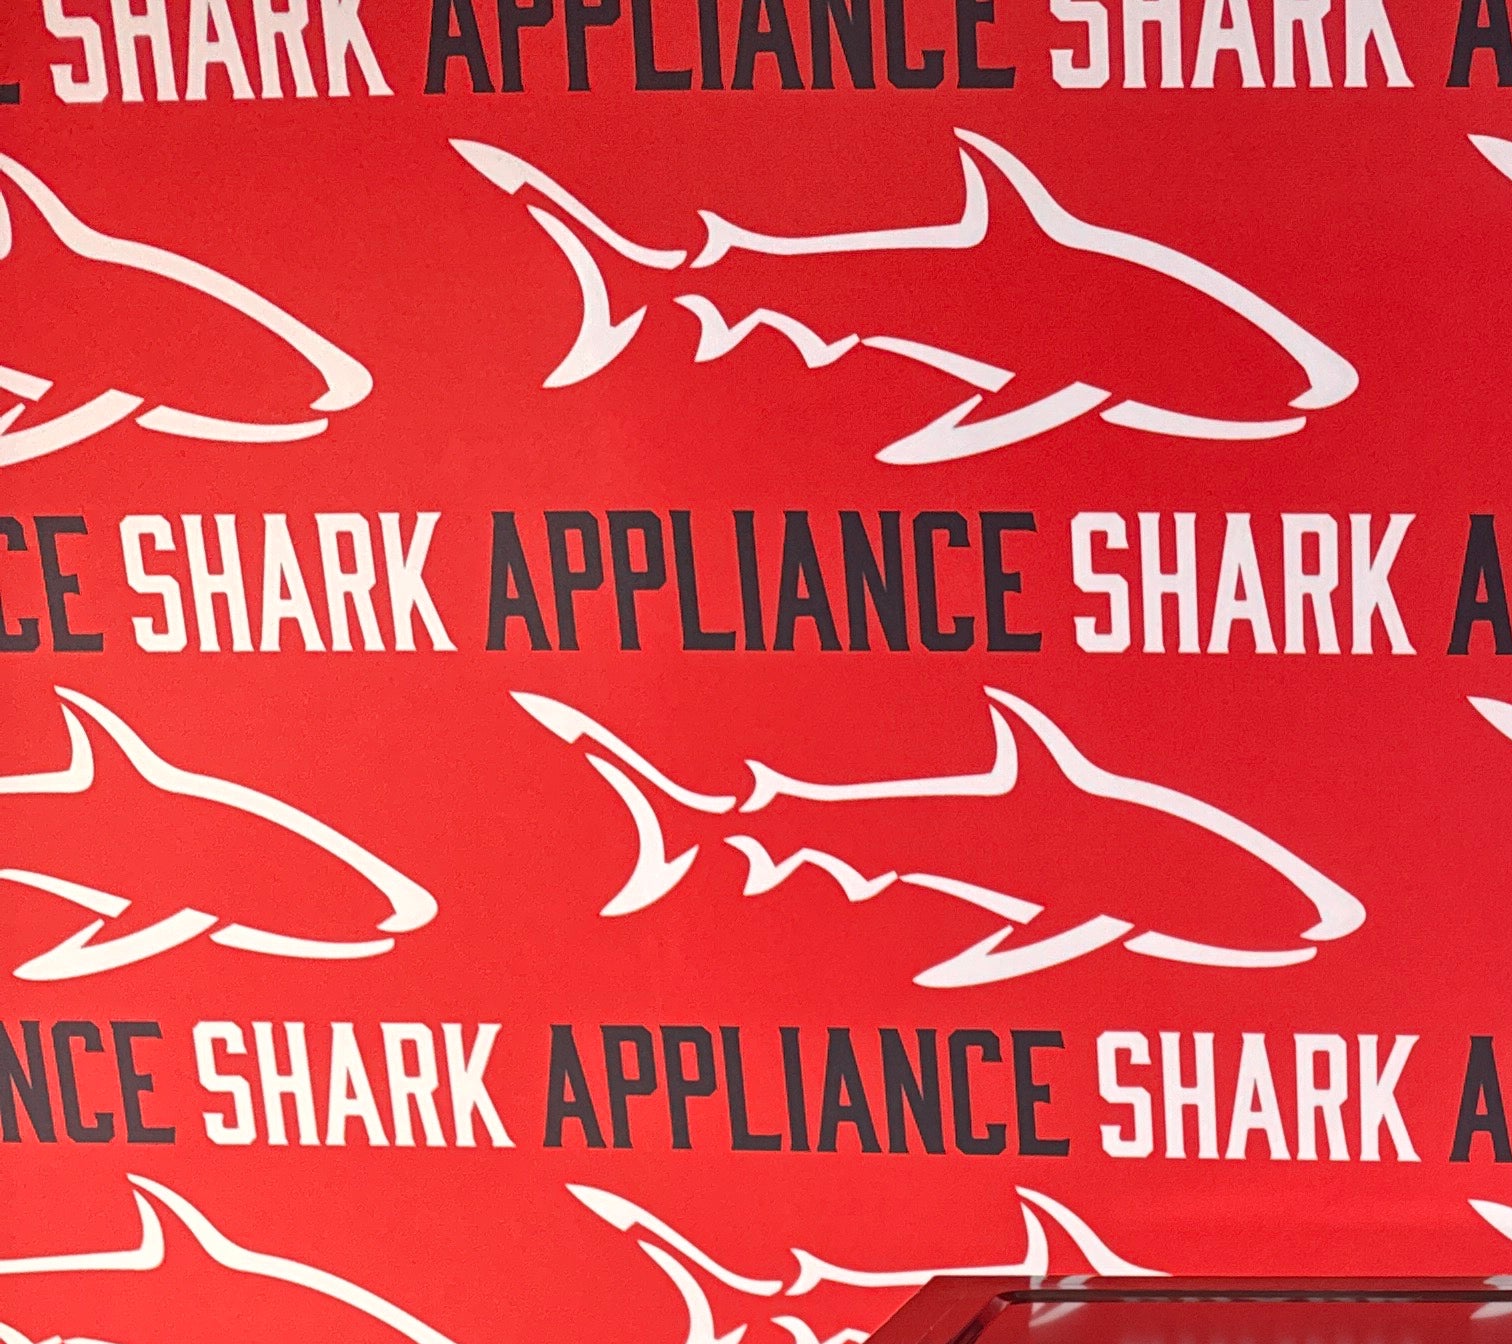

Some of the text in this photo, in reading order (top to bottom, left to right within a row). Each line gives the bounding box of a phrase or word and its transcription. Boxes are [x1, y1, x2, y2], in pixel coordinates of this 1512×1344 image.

[41, 0, 393, 103] SHARK
[426, 0, 1014, 93] APPLIANCE
[1050, 0, 1413, 88] SHARK
[120, 512, 457, 652] SHARK
[488, 511, 1040, 651] APPLIANCE
[1071, 513, 1416, 654] SHARK
[193, 1021, 515, 1147] SHARK
[545, 1026, 1068, 1155] APPLIANCE
[1097, 1031, 1420, 1161] SHARK
